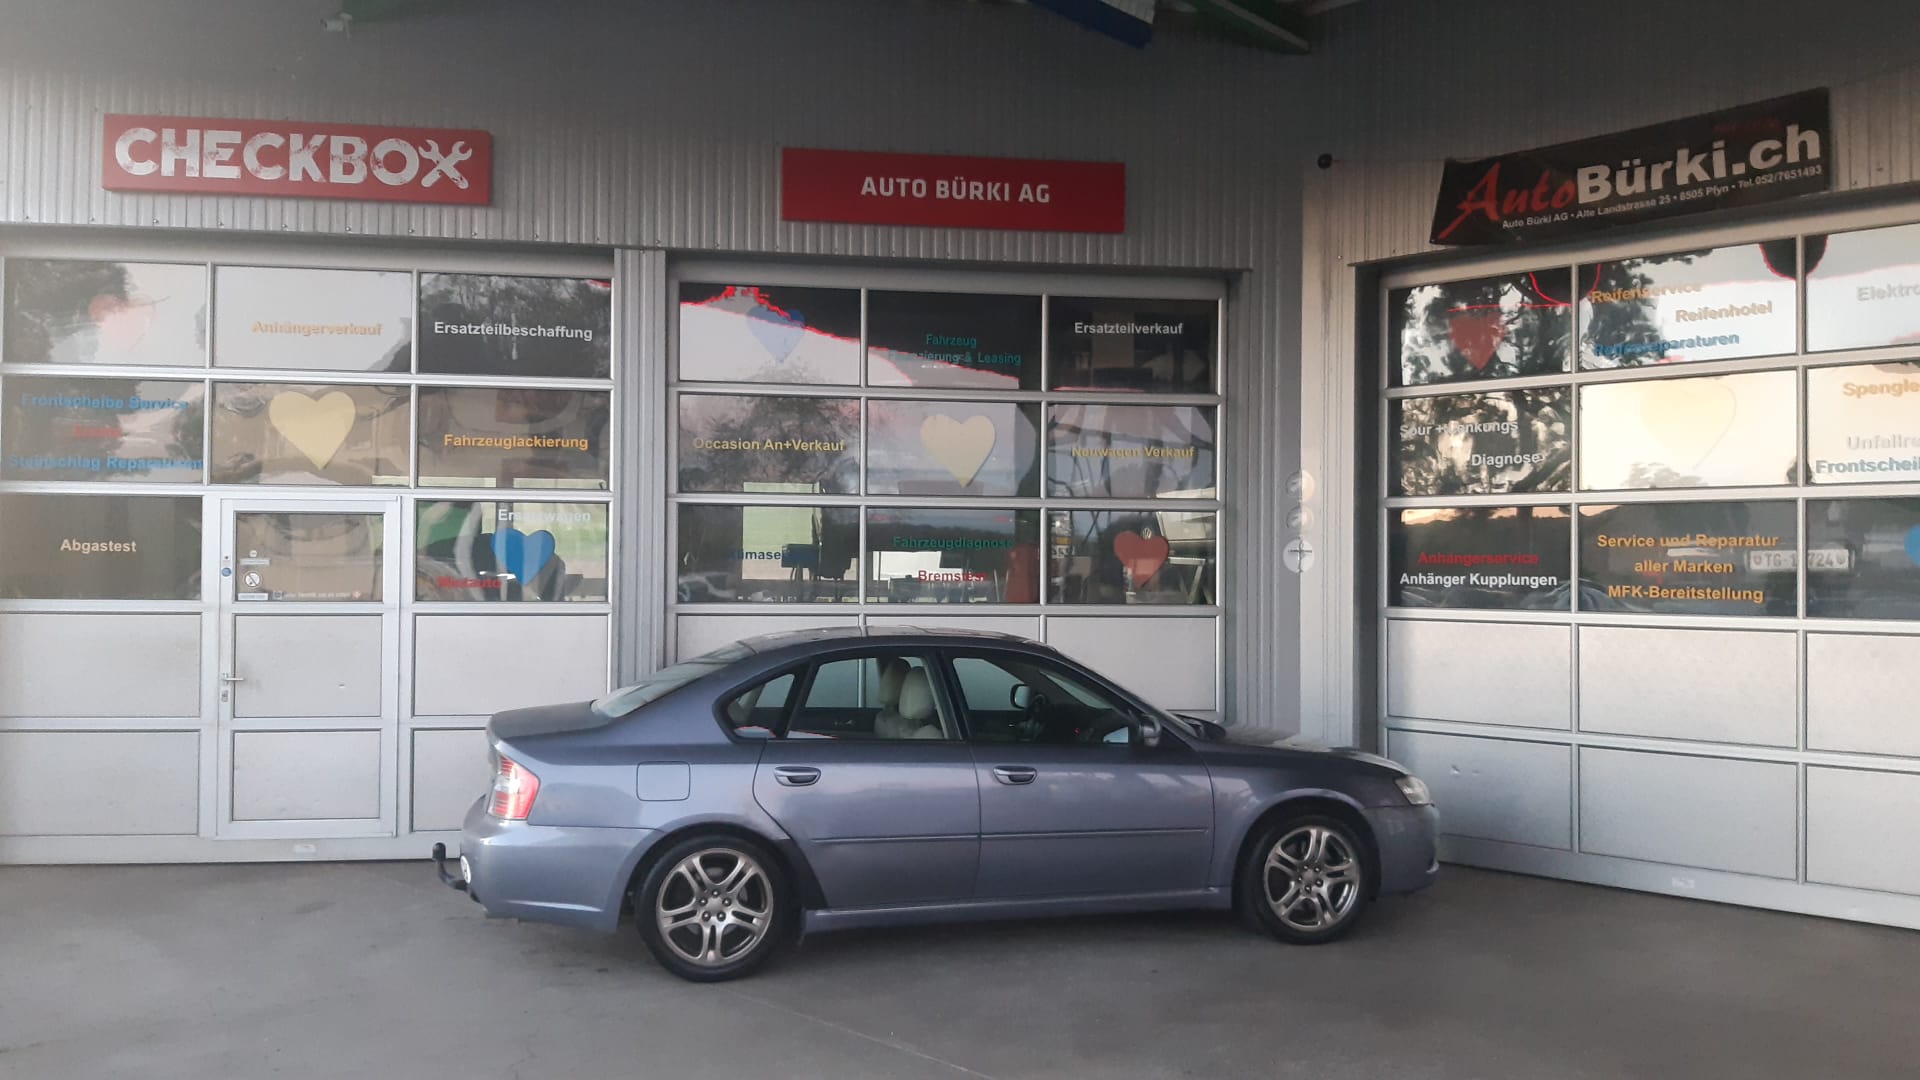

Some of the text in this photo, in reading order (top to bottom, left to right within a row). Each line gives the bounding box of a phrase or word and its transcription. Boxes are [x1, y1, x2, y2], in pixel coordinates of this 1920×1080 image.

[115, 127, 472, 189] CHECKBOX
[861, 174, 1050, 204] AUTO BÜRKI AG
[1502, 219, 1525, 229] Auto
[1553, 212, 1568, 222] AG
[1576, 208, 1595, 219] Alte
[1597, 198, 1657, 216] Landstrasse
[1591, 284, 1703, 303] Reifenservice
[1675, 301, 1773, 323] Reifenhotel
[434, 320, 593, 342] Ersatzteilbeschaffung
[1074, 320, 1183, 337] Ersatzteilverkauf
[926, 334, 977, 348] Fahrzeug
[977, 352, 1022, 365] Leasing
[444, 432, 589, 451] Fahrzeuglackierung
[693, 437, 760, 450] Occasion
[1144, 446, 1195, 458] Verkauf
[1471, 453, 1540, 468] Diagnose
[1816, 456, 1920, 474] Frontschei
[60, 538, 137, 554] Abgastest
[893, 536, 1015, 551] Fahrzeugdiagnose
[1597, 534, 1779, 549] Service und Reparatur
[1418, 552, 1540, 567] Anhängerservice
[1634, 560, 1733, 573] aller Marken
[1400, 573, 1558, 588] Anhänger Kupplungen
[1608, 585, 1764, 604] MFK-Bereitstellung
